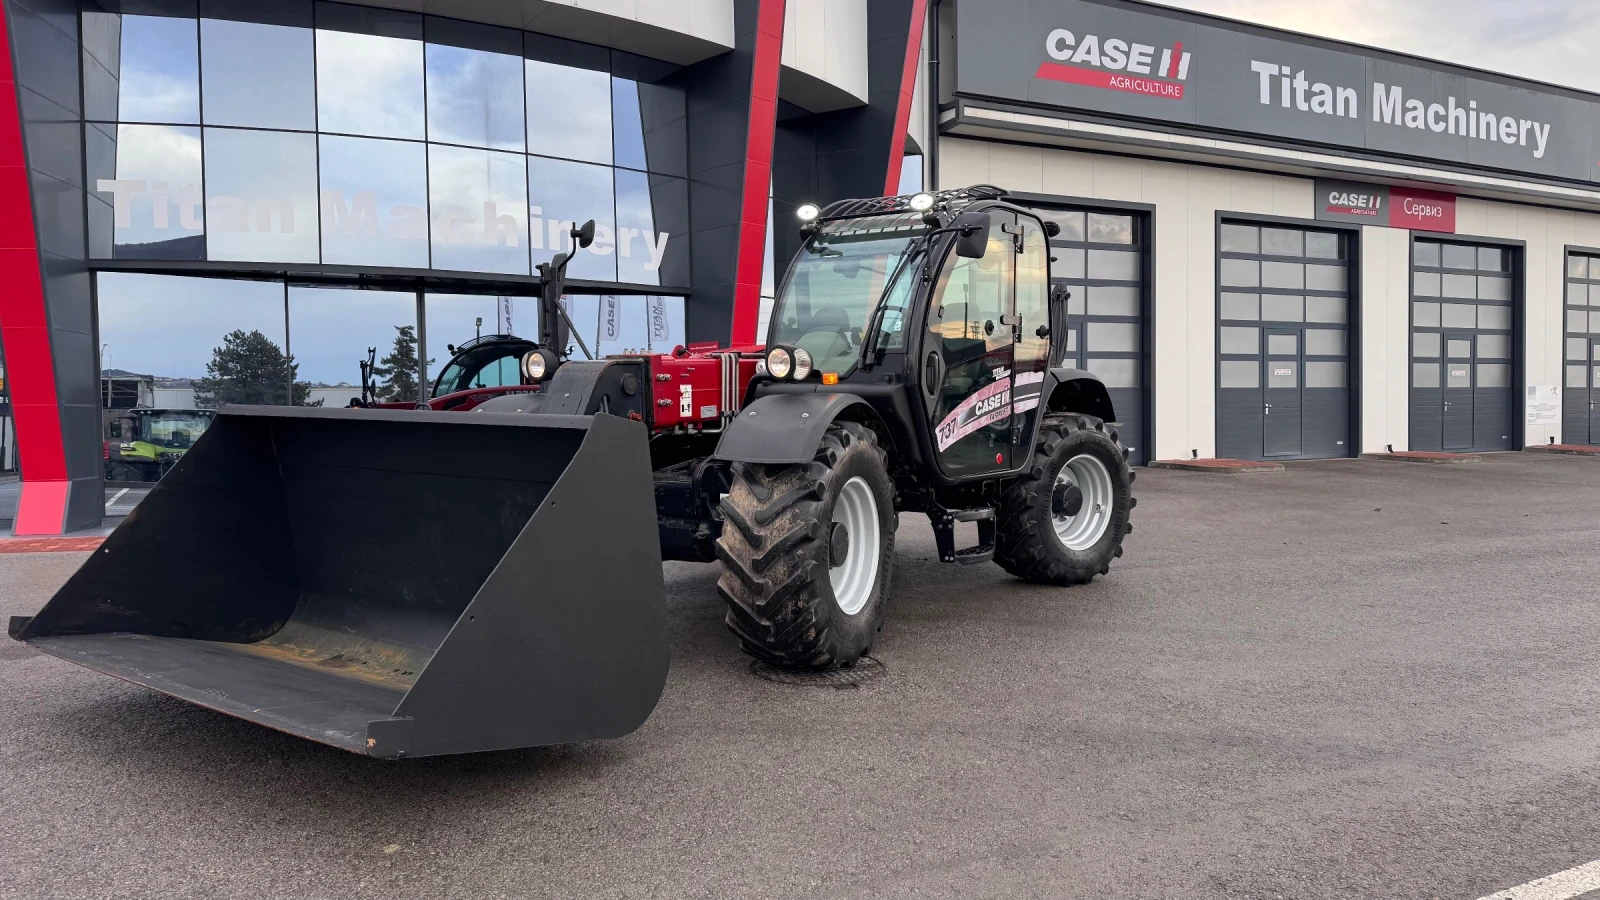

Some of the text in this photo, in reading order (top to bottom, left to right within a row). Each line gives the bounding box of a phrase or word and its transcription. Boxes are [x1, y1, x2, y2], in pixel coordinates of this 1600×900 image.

[1045, 28, 1192, 80] CASE IH
[1109, 76, 1180, 97] AGRICULTURE
[1250, 60, 1551, 159] Titan Machinery
[1328, 191, 1368, 208] CASE
[1350, 208, 1377, 216] AGRICULTURE
[1403, 197, 1442, 221] Сервиз
[96, 178, 670, 272] Titan Machinery
[607, 299, 615, 337] CASE
[975, 393, 1001, 416] CASE
[939, 417, 957, 445] 737
